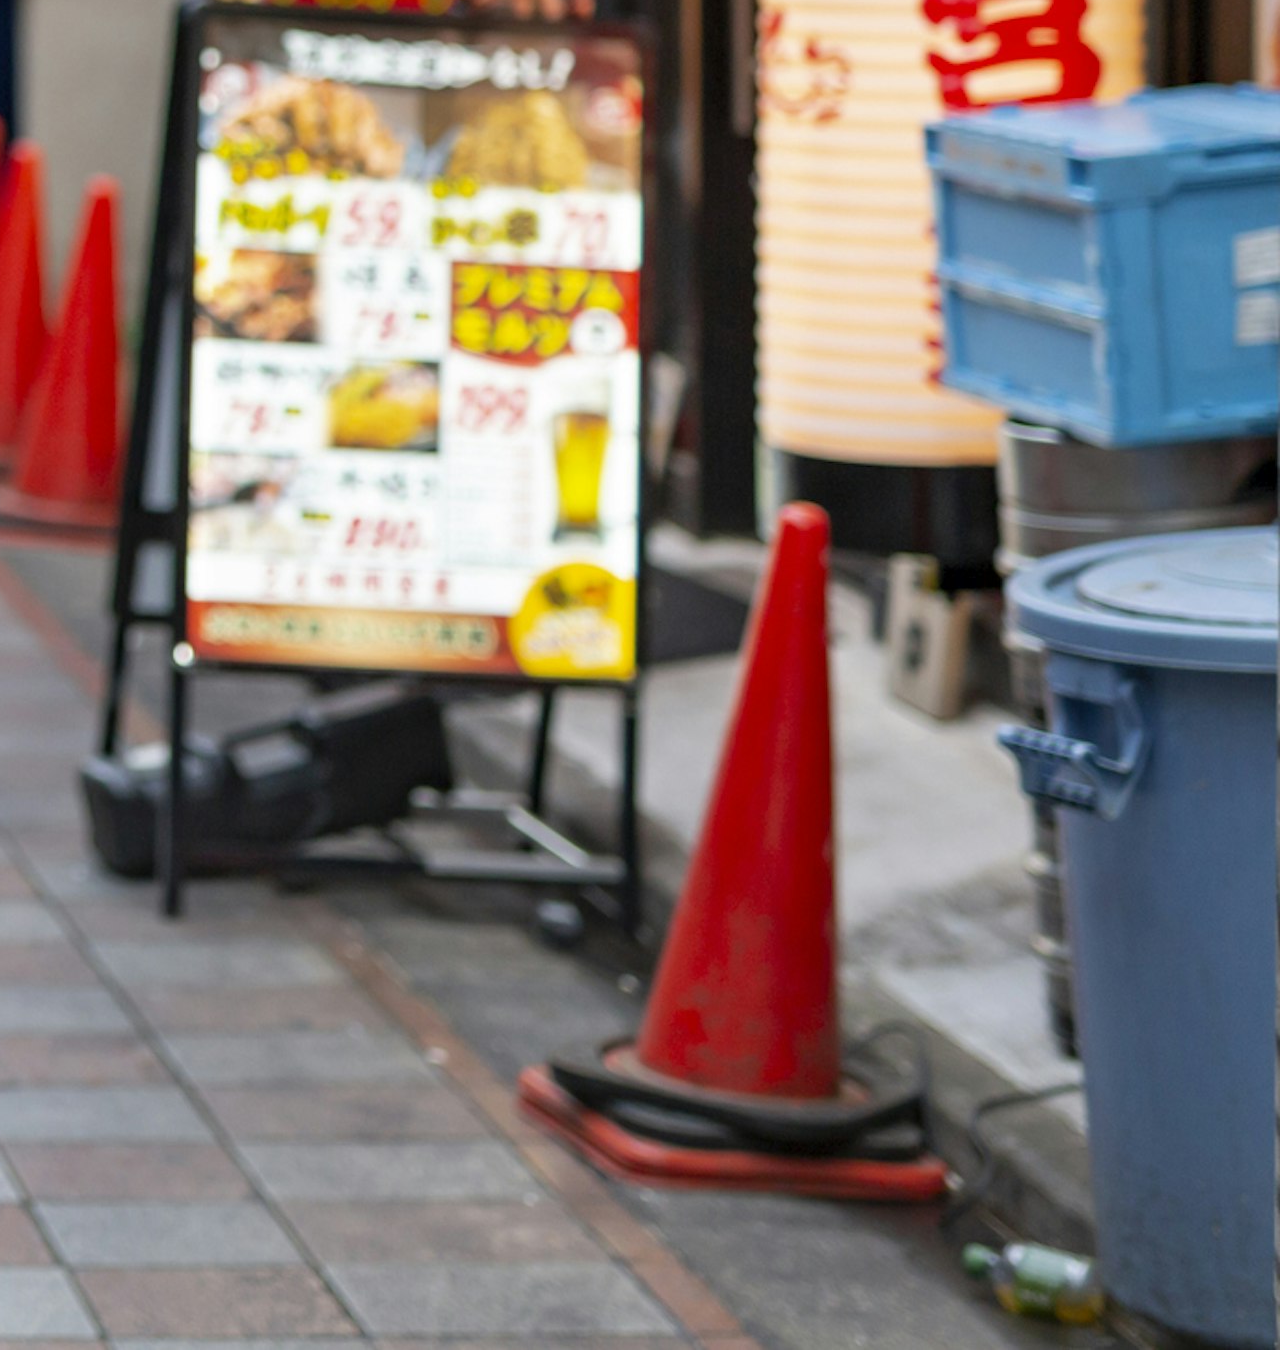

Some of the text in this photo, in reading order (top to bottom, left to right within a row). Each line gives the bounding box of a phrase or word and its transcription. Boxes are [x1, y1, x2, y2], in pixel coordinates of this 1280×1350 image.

[454, 263, 624, 312] プレミアム
[452, 307, 572, 358] モルツ
